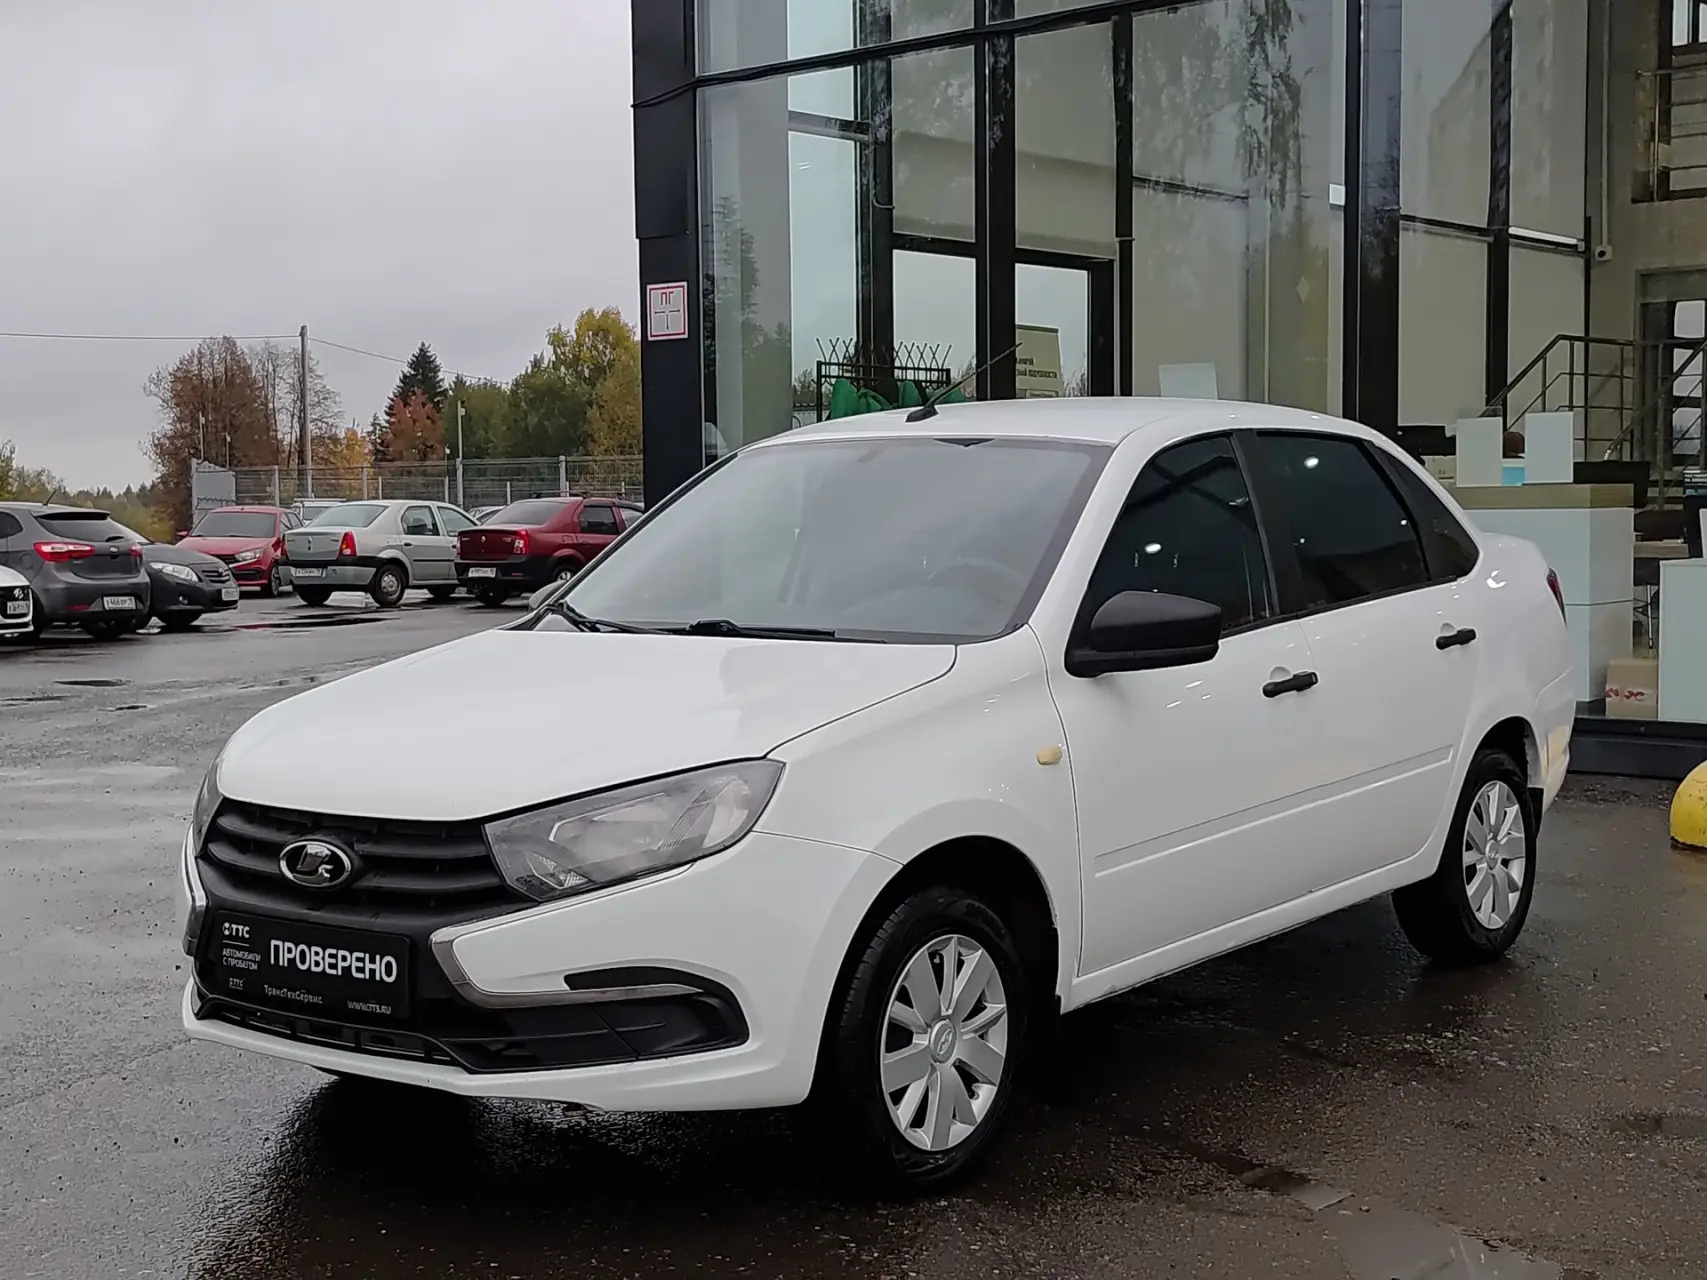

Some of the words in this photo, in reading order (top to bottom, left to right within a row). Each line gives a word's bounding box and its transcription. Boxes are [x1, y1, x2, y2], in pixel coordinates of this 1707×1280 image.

[222, 948, 261, 962] АВТОМОБИЛИ
[270, 939, 397, 983] ПРОВЕРЕНО
[222, 957, 227, 966] С
[228, 957, 258, 971] ПРОБЕГОМ
[264, 984, 323, 1004] ТрансТехСервис
